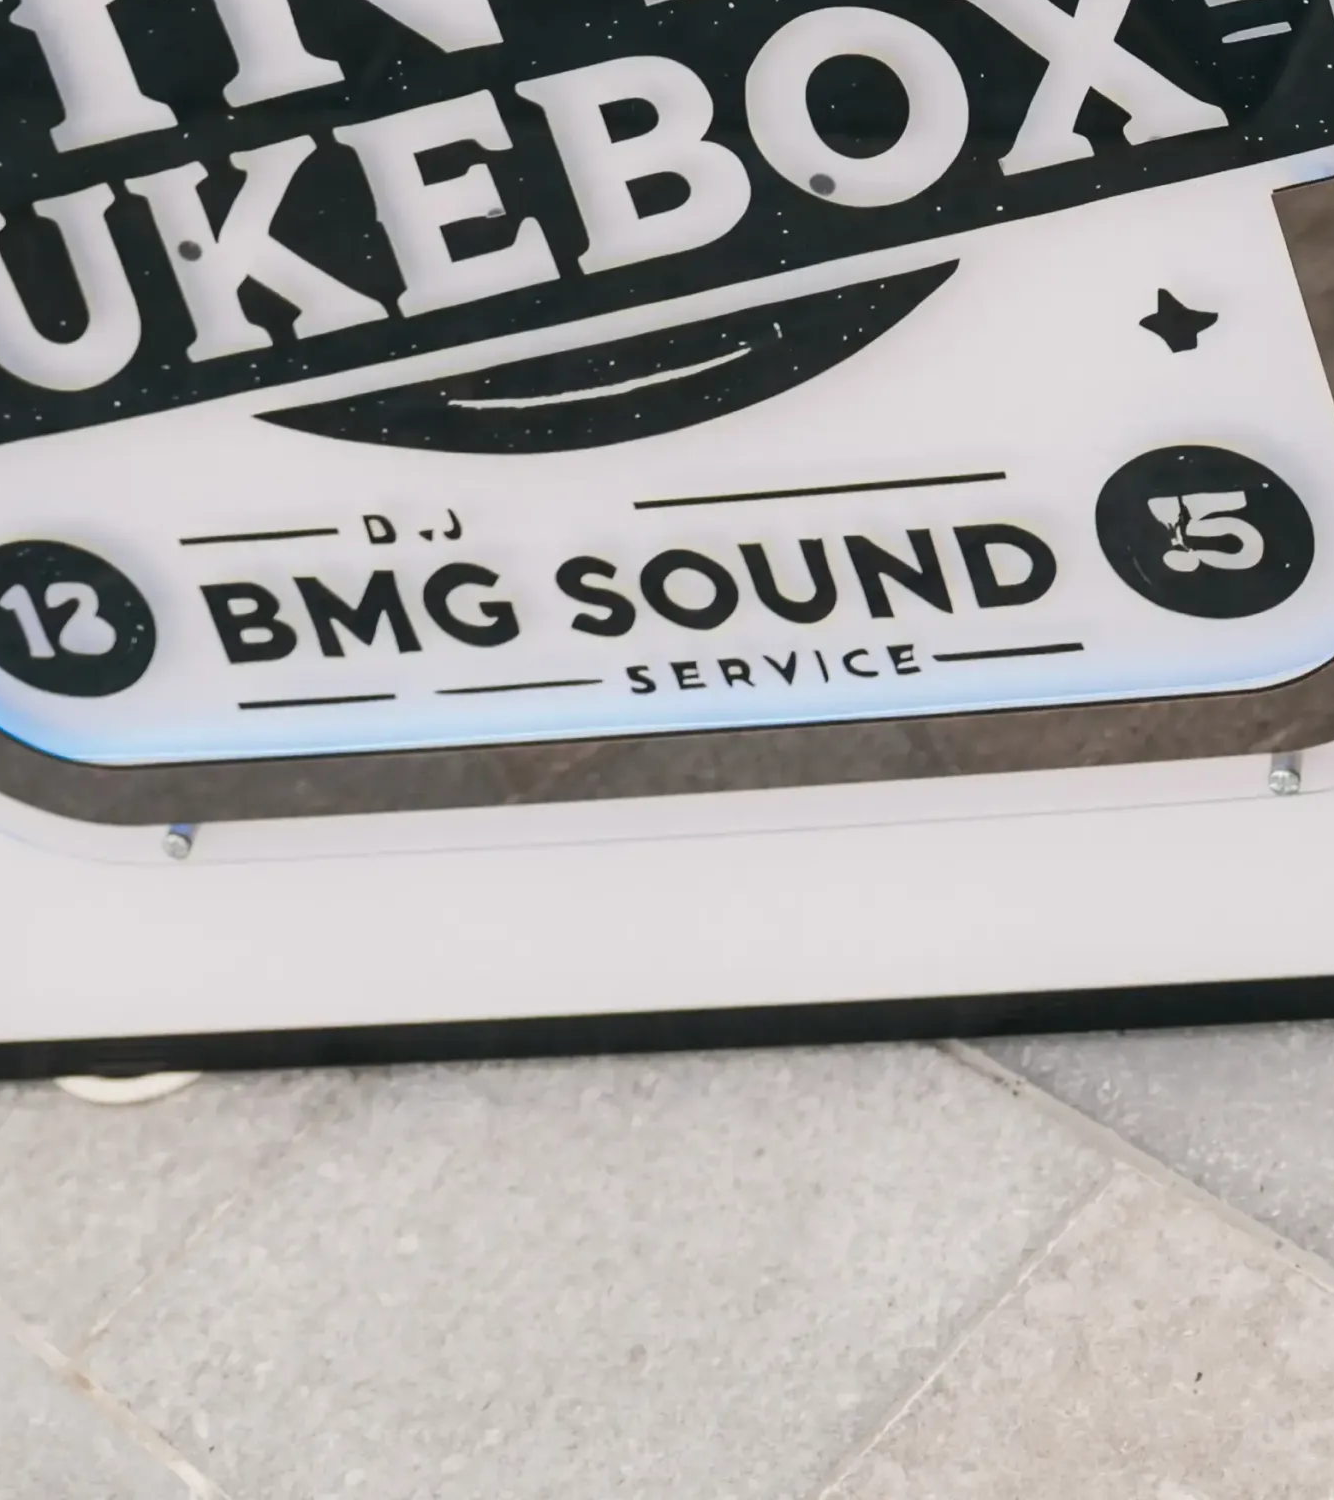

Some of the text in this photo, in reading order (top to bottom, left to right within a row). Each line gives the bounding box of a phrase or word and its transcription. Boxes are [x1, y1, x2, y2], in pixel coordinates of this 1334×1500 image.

[199, 523, 1057, 664] BMG SOUND
[626, 644, 922, 694] SERVICE
